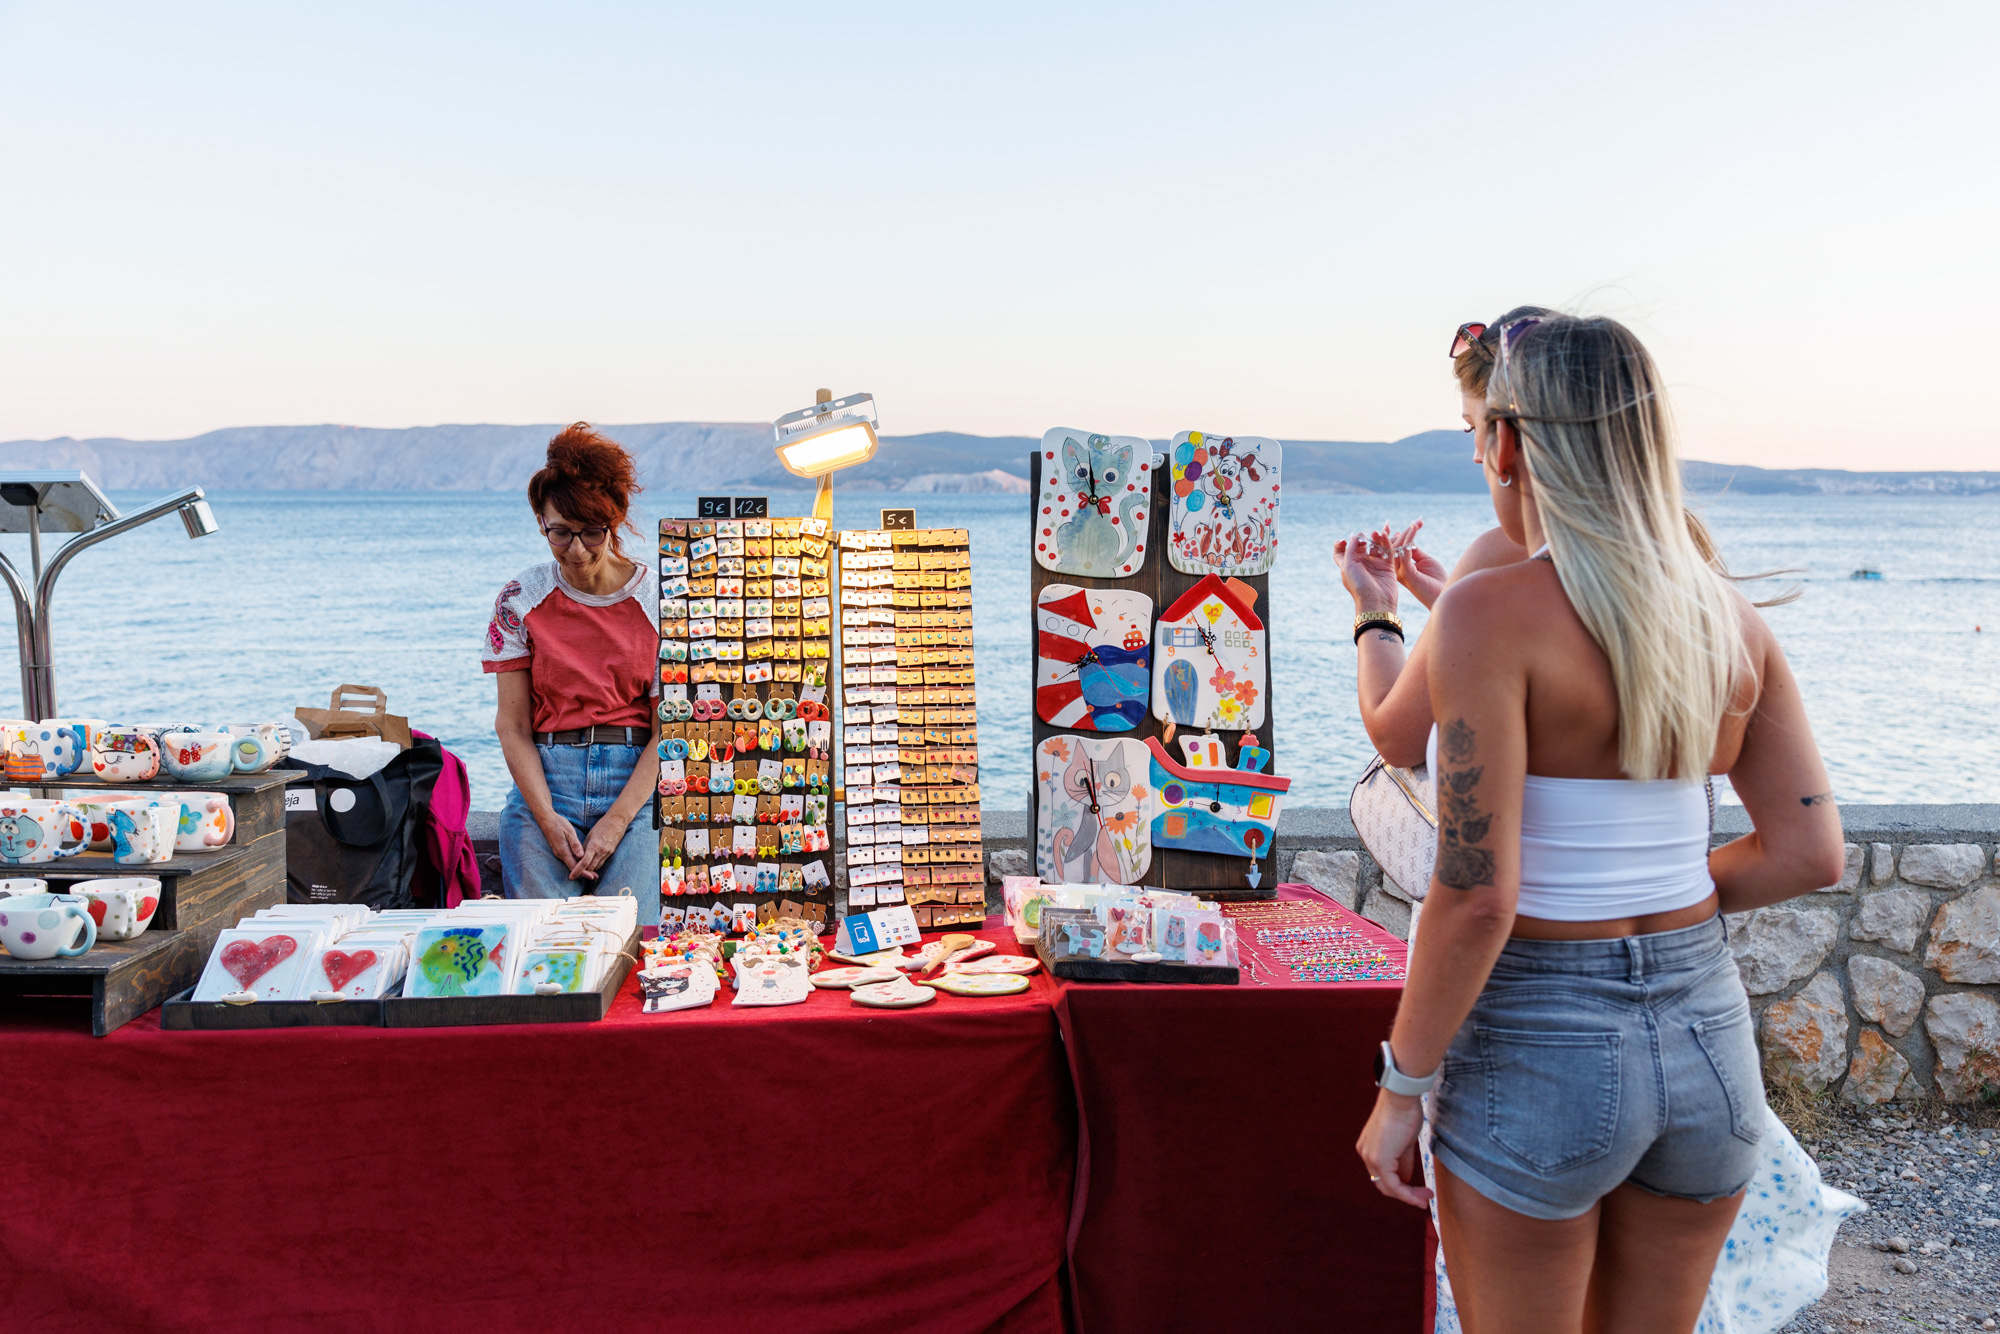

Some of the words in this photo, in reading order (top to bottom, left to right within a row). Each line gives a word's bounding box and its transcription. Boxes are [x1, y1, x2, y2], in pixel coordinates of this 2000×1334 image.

[1271, 466, 1278, 474] 2
[1274, 498, 1280, 507] 3
[1231, 619, 1238, 628] 1
[1244, 631, 1253, 640] 2
[1168, 646, 1175, 657] 9
[1249, 647, 1257, 657] 3
[1242, 663, 1248, 673] 4
[1189, 800, 1193, 808] 9
